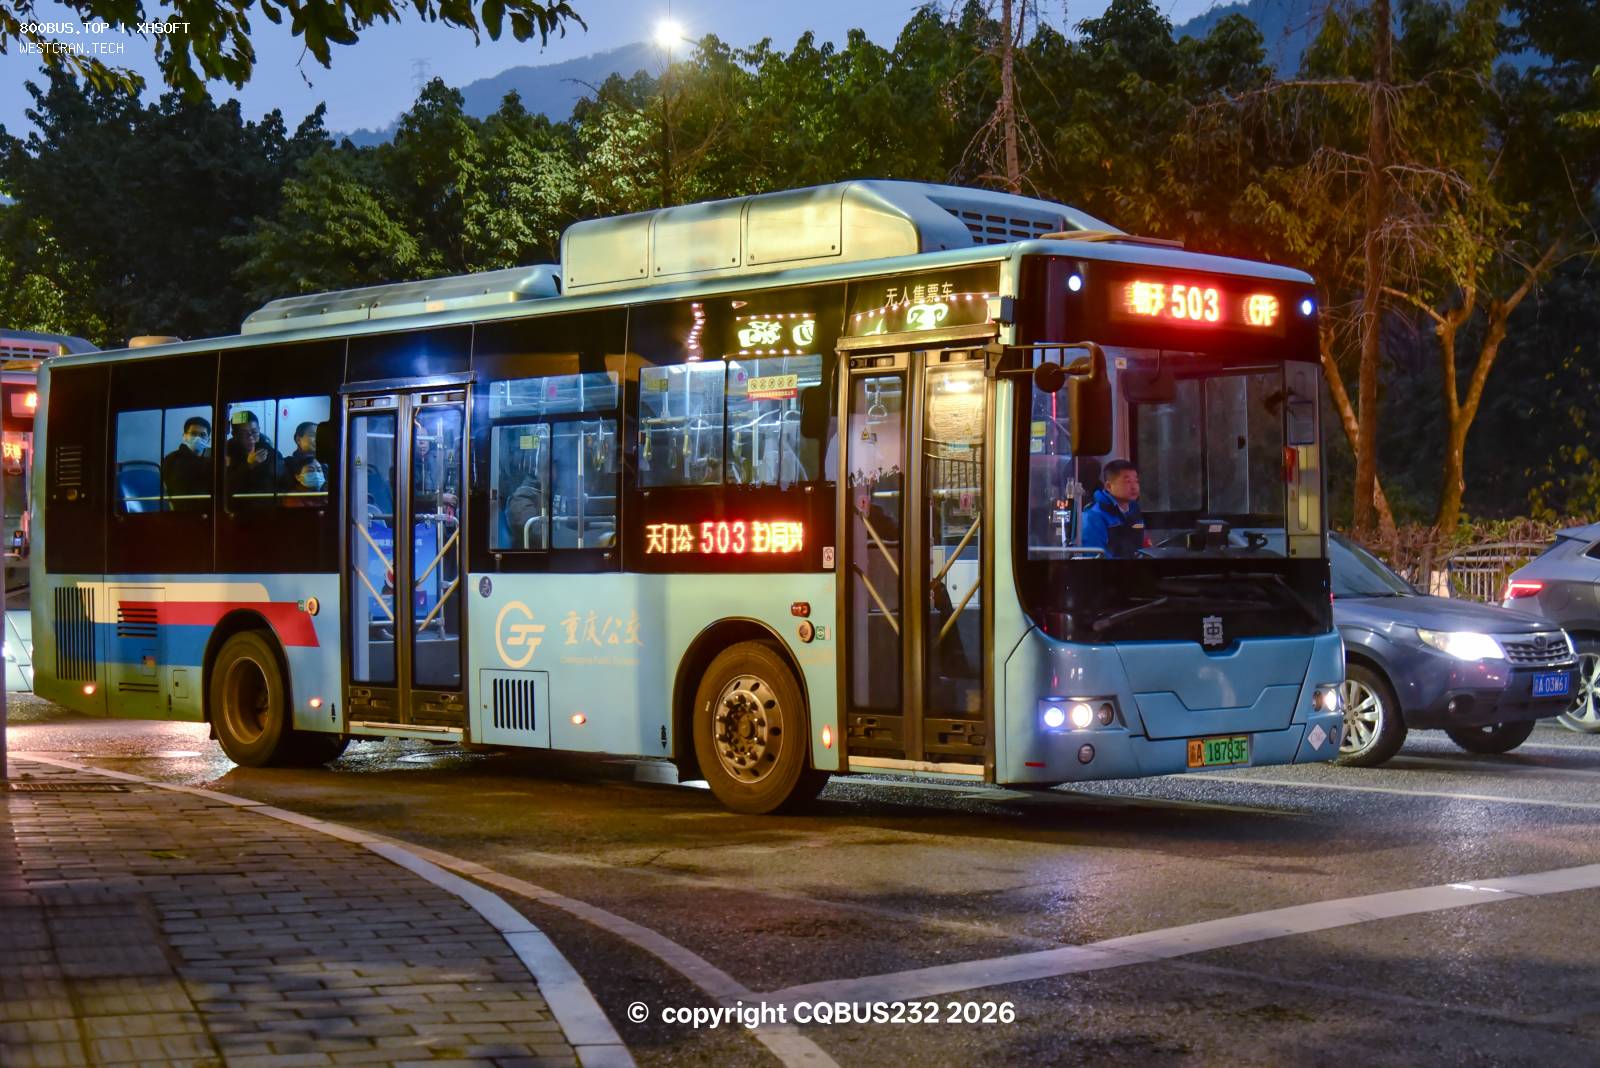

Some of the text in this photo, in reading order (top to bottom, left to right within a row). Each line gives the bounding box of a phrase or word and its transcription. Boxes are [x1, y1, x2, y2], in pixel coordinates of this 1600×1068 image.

[885, 281, 954, 307] 无人售票车
[1170, 284, 1220, 322] 503
[701, 520, 746, 554] 503
[559, 608, 645, 647] 重庆公交
